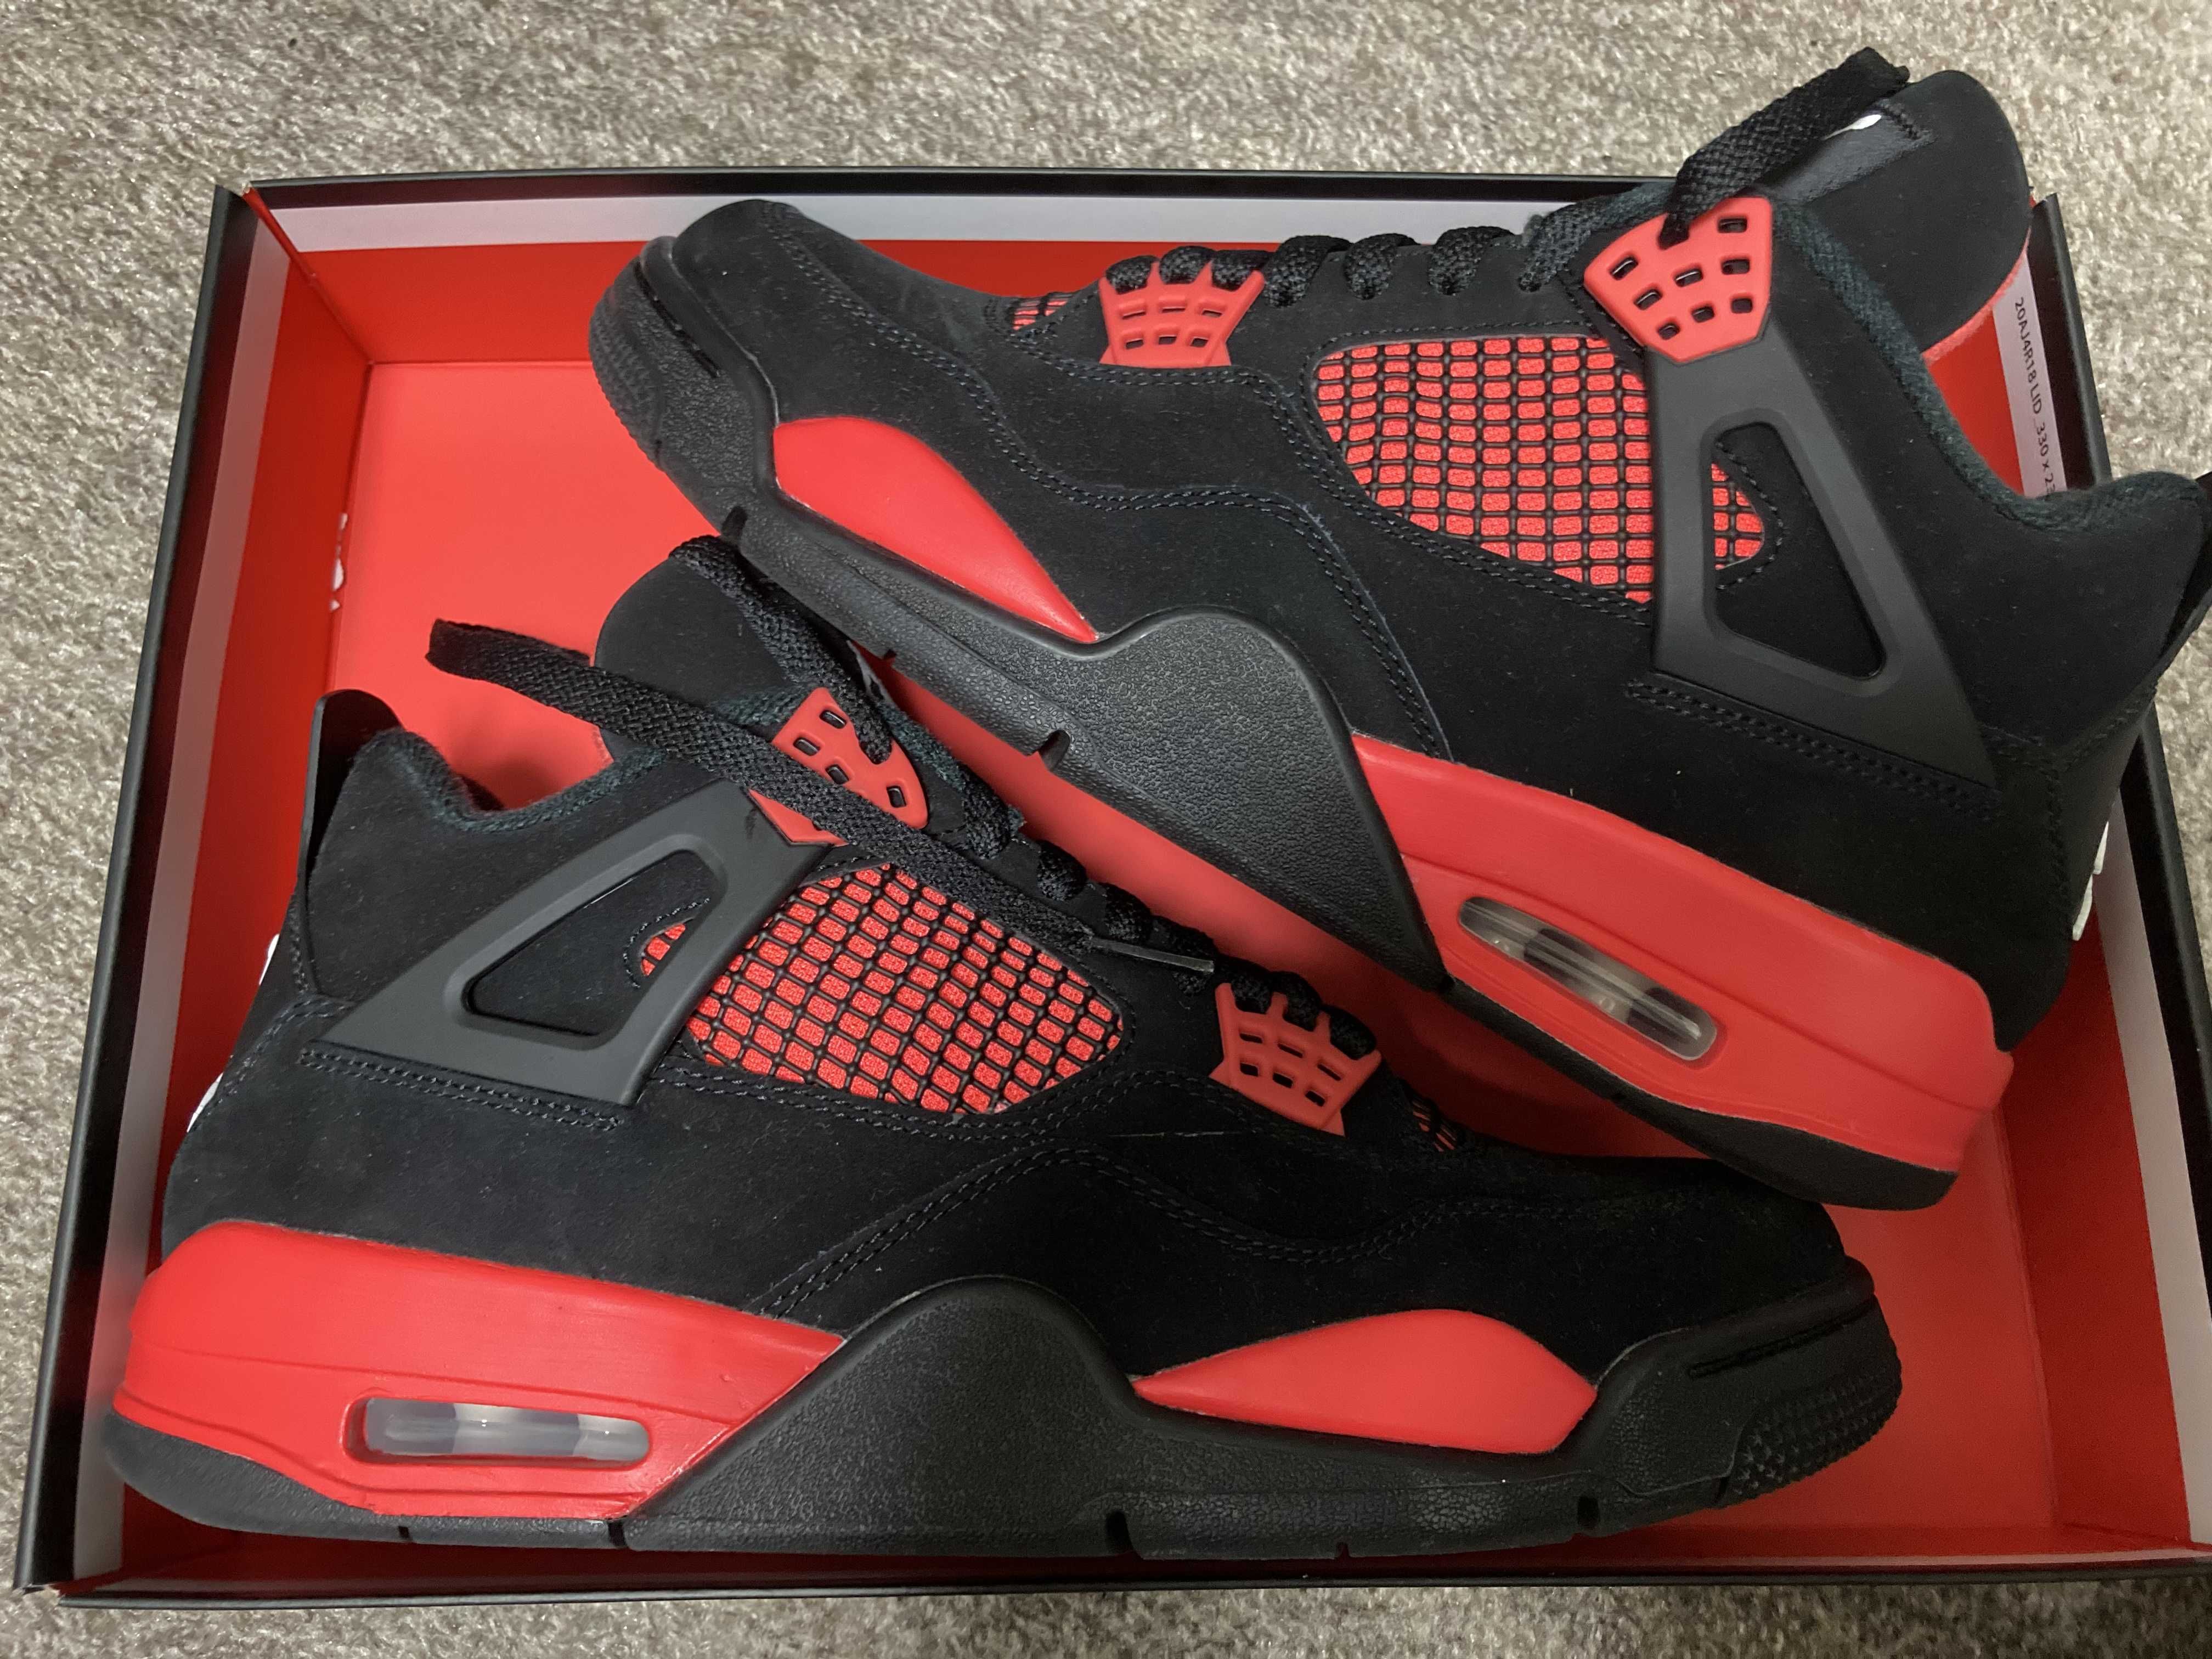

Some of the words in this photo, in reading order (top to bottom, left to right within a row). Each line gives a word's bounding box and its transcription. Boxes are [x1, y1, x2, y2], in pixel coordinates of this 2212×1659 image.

[2015, 297, 2036, 383] 20AJ4R18
[2030, 383, 2042, 414] LID
[2042, 460, 2050, 470] x
